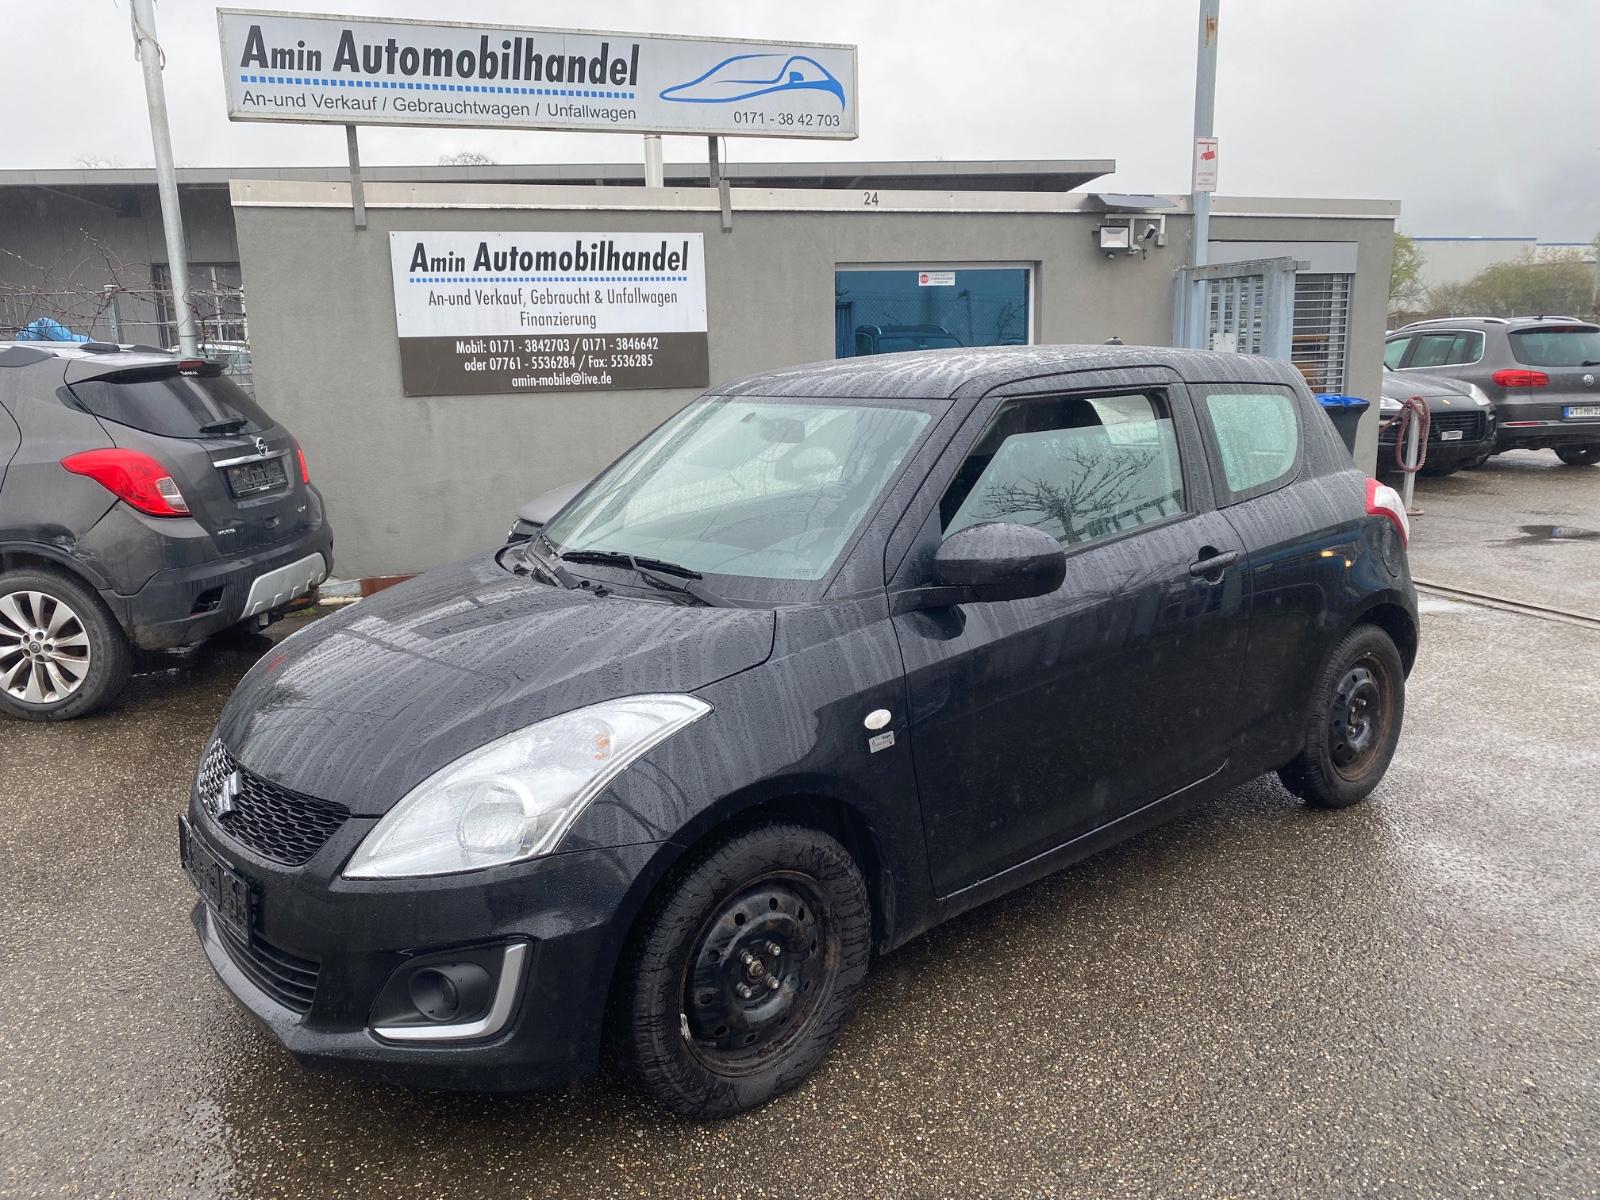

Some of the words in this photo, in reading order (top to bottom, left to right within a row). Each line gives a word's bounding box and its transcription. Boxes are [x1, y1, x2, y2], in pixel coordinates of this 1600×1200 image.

[240, 24, 322, 72] Amin
[332, 29, 640, 86] Automobilhandel
[242, 90, 307, 109] An-und
[311, 93, 377, 111] Verkauf
[392, 97, 530, 118] Gebrauchtwagen
[547, 103, 637, 122] Unfallwagen
[733, 111, 764, 125] 0171
[778, 112, 794, 125] 38
[797, 113, 813, 126] 42
[817, 114, 840, 127] 703
[863, 191, 879, 206] 24
[409, 242, 466, 273] Amin
[473, 240, 689, 272] Automobilhandel
[428, 289, 471, 306] An-und
[475, 288, 527, 308] Verkauf,
[530, 288, 591, 305] Gebraucht
[594, 291, 603, 304] &
[607, 288, 678, 307] Unfallwagen
[520, 311, 597, 329] Finanzierung
[456, 339, 487, 354] Mobil:
[490, 339, 515, 353] 0171
[525, 338, 570, 353] 3842703
[572, 338, 580, 354] /
[582, 338, 607, 352] 0171
[616, 337, 659, 351] 3846642
[464, 356, 487, 371] oder
[489, 356, 521, 370] 07761
[531, 355, 576, 370] 5536284
[578, 354, 585, 370] /
[588, 355, 608, 369] Fax:
[610, 354, 653, 368] 5536285
[512, 371, 612, 388] amin-mobile@live.de
